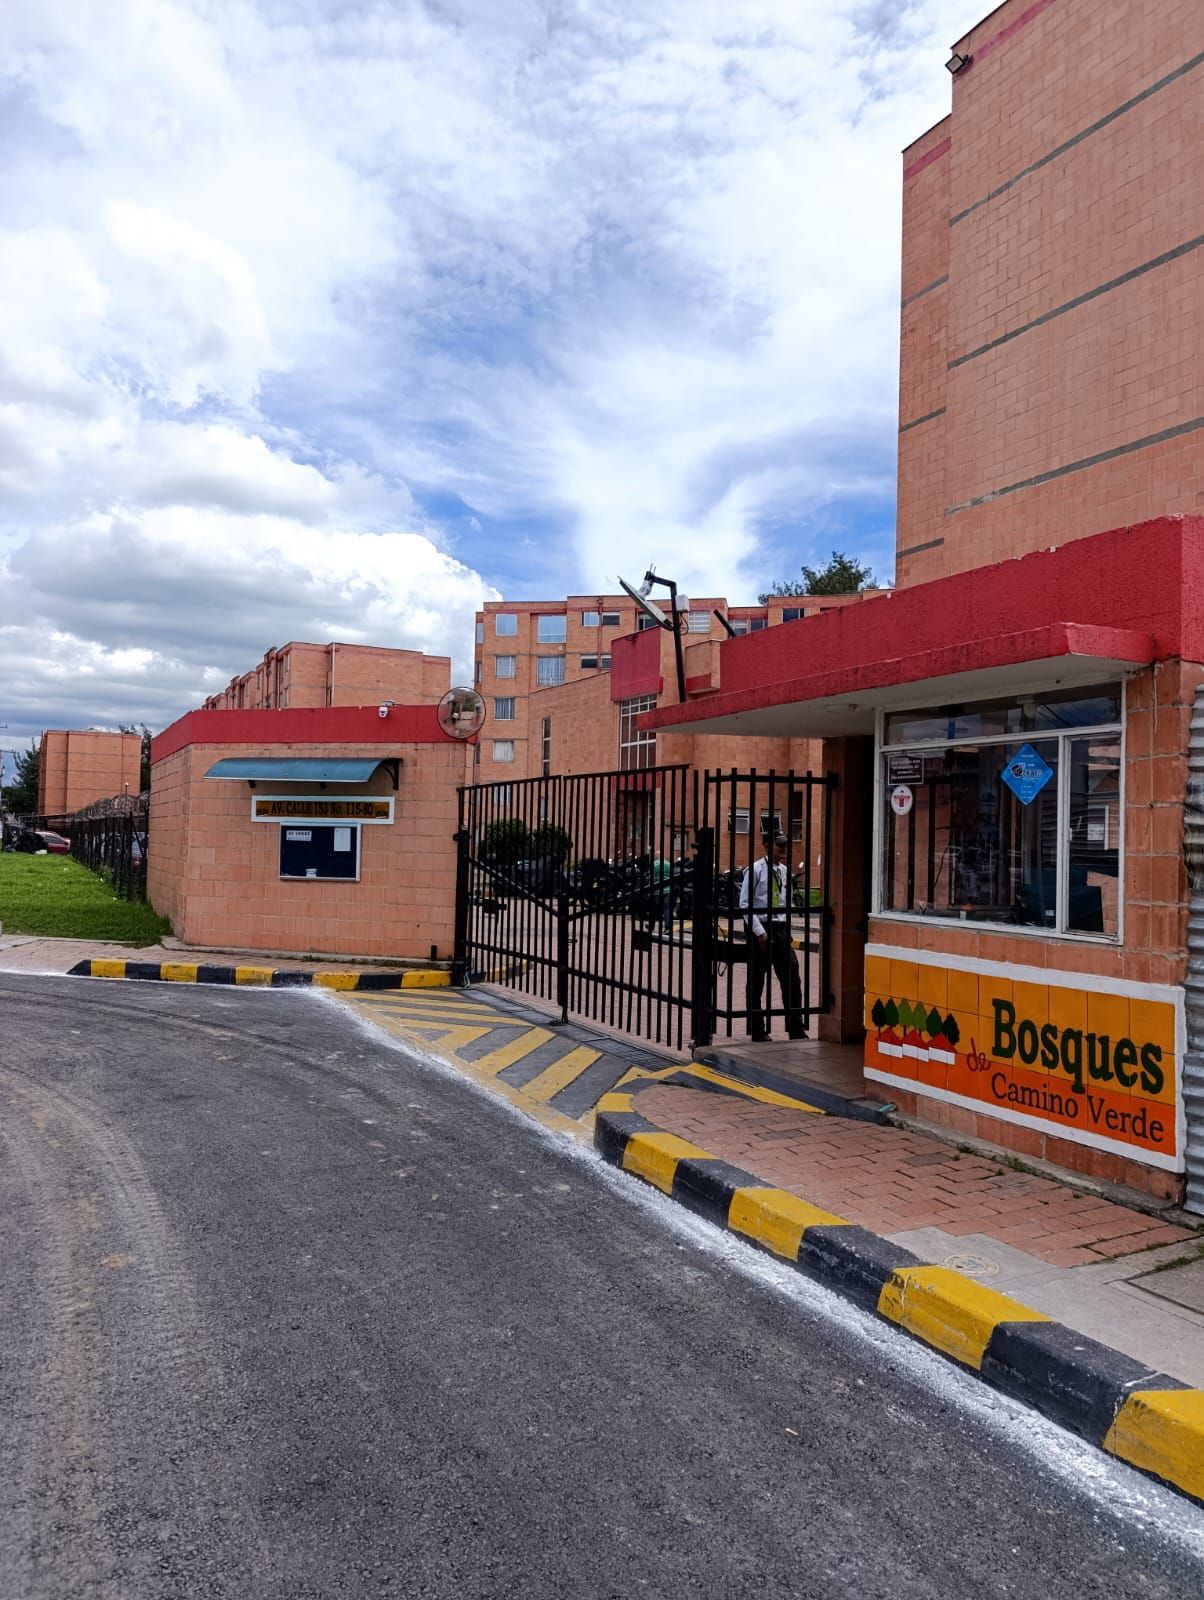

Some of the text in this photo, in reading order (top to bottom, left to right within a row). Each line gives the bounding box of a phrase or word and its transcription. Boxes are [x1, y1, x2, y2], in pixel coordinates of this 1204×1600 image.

[271, 801, 284, 814] AV.
[286, 801, 312, 815] CALLE
[966, 1037, 992, 1072] de
[991, 997, 1165, 1095] Bosques
[991, 1072, 1164, 1143] Camino Verde
